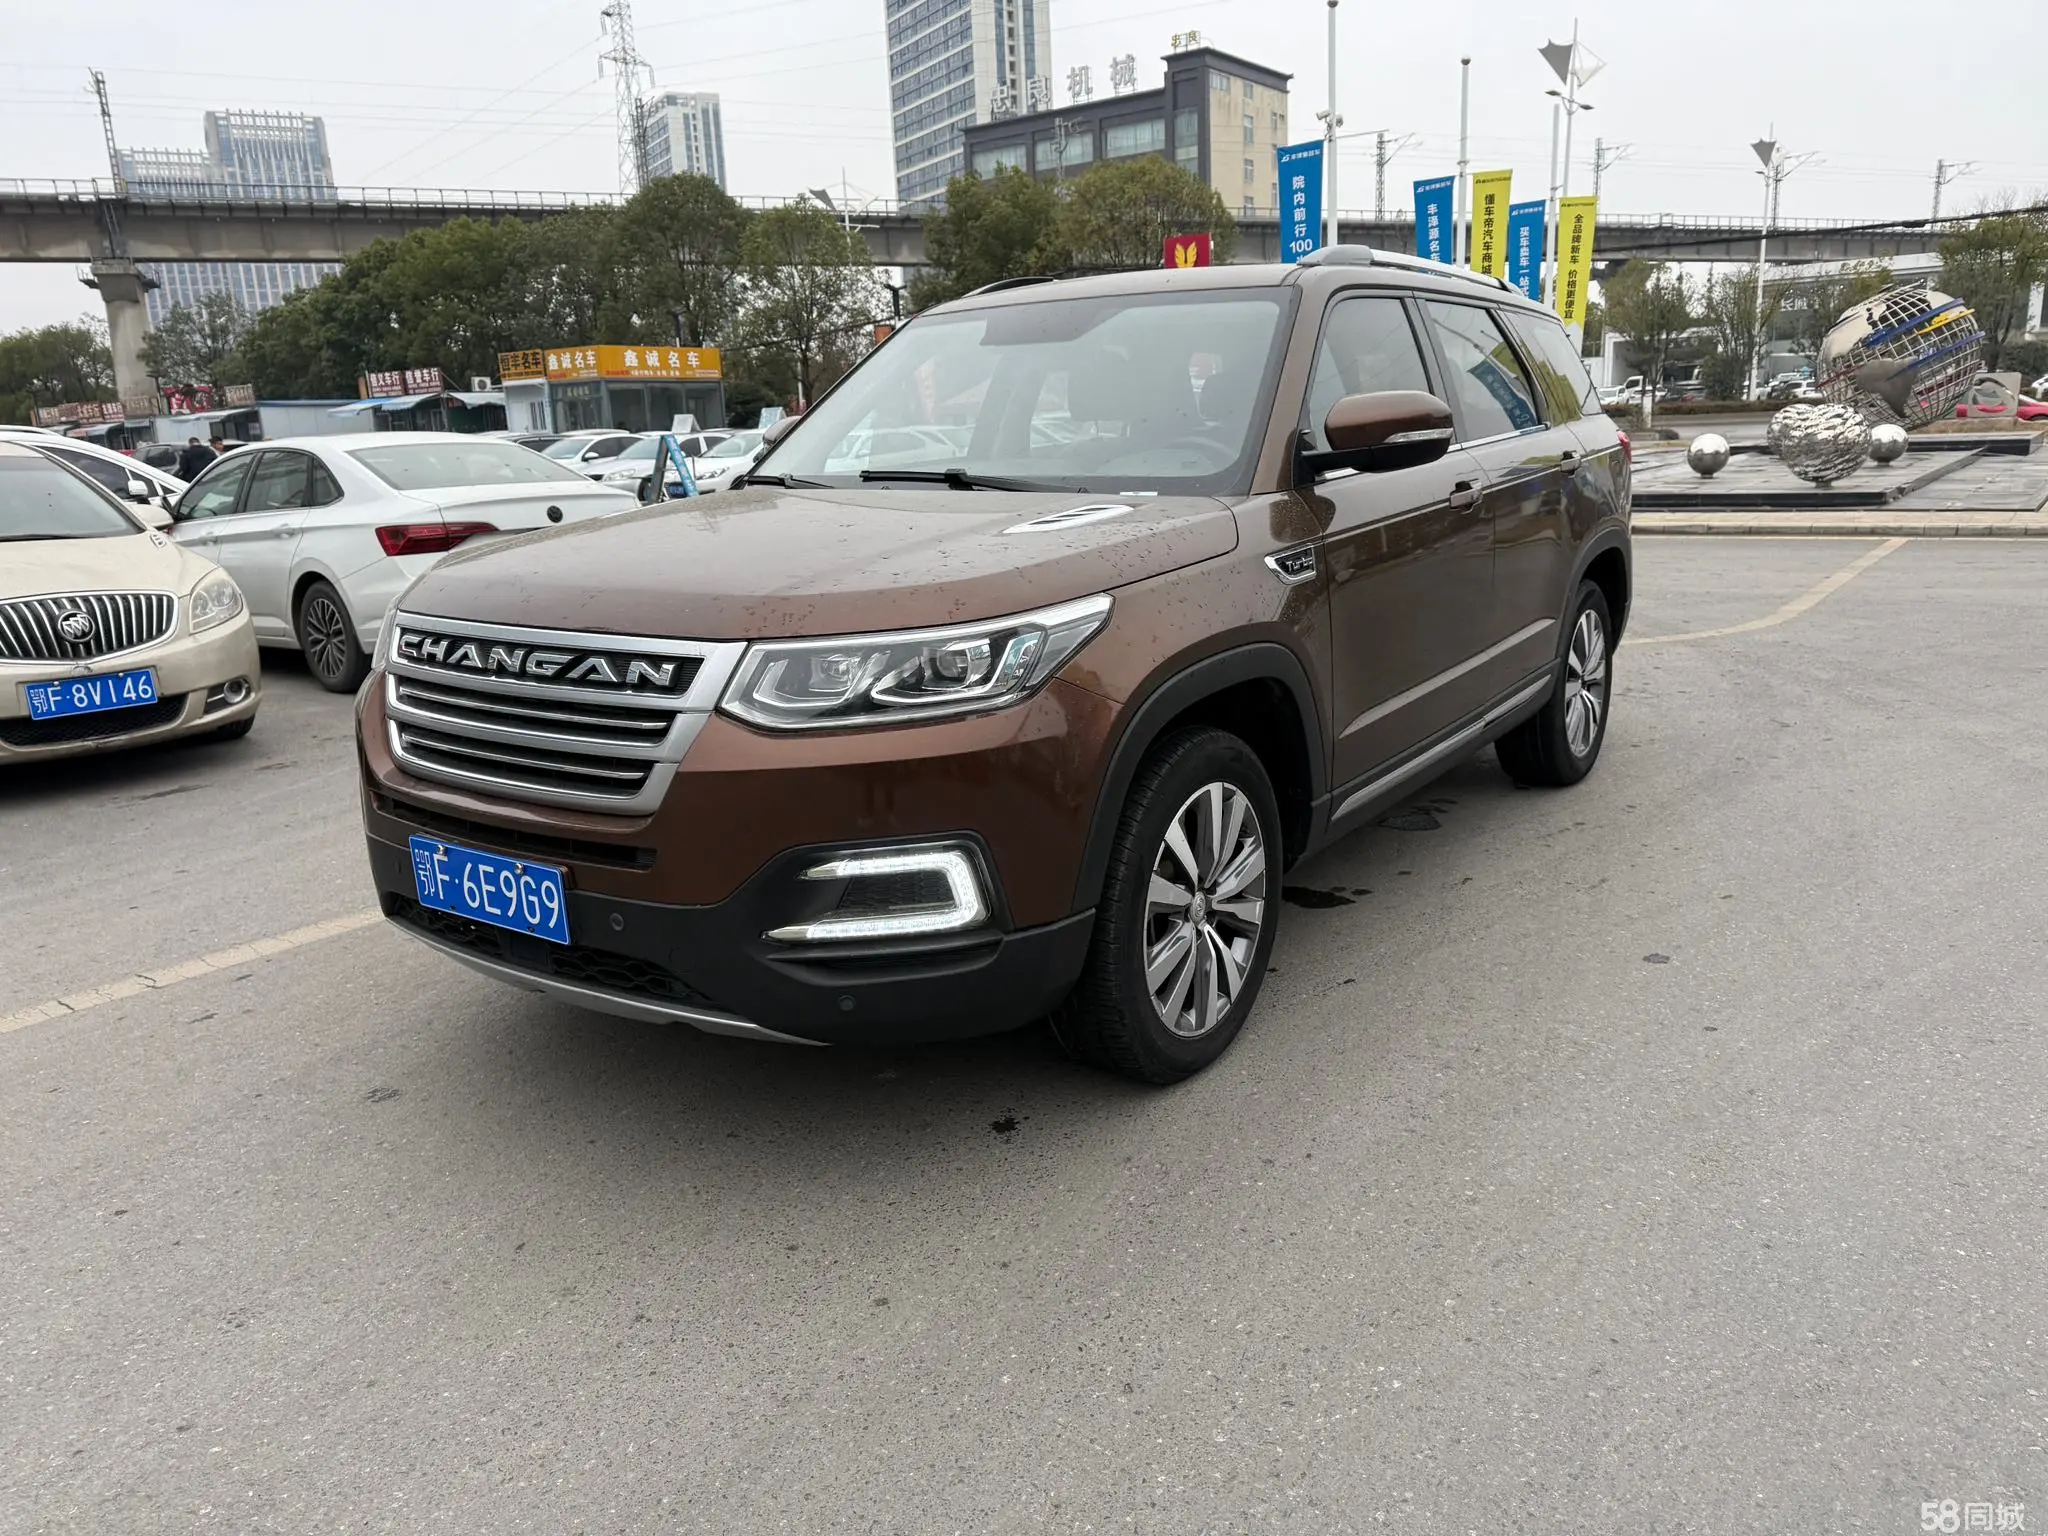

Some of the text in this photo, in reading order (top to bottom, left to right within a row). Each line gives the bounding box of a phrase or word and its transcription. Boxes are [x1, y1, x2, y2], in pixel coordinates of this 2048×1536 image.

[1569, 213, 1584, 265] 全品牌新车
[1563, 269, 1578, 319] 价格更便宜
[623, 349, 700, 368] 鑫诚名车
[400, 631, 682, 688] CHANGAN
